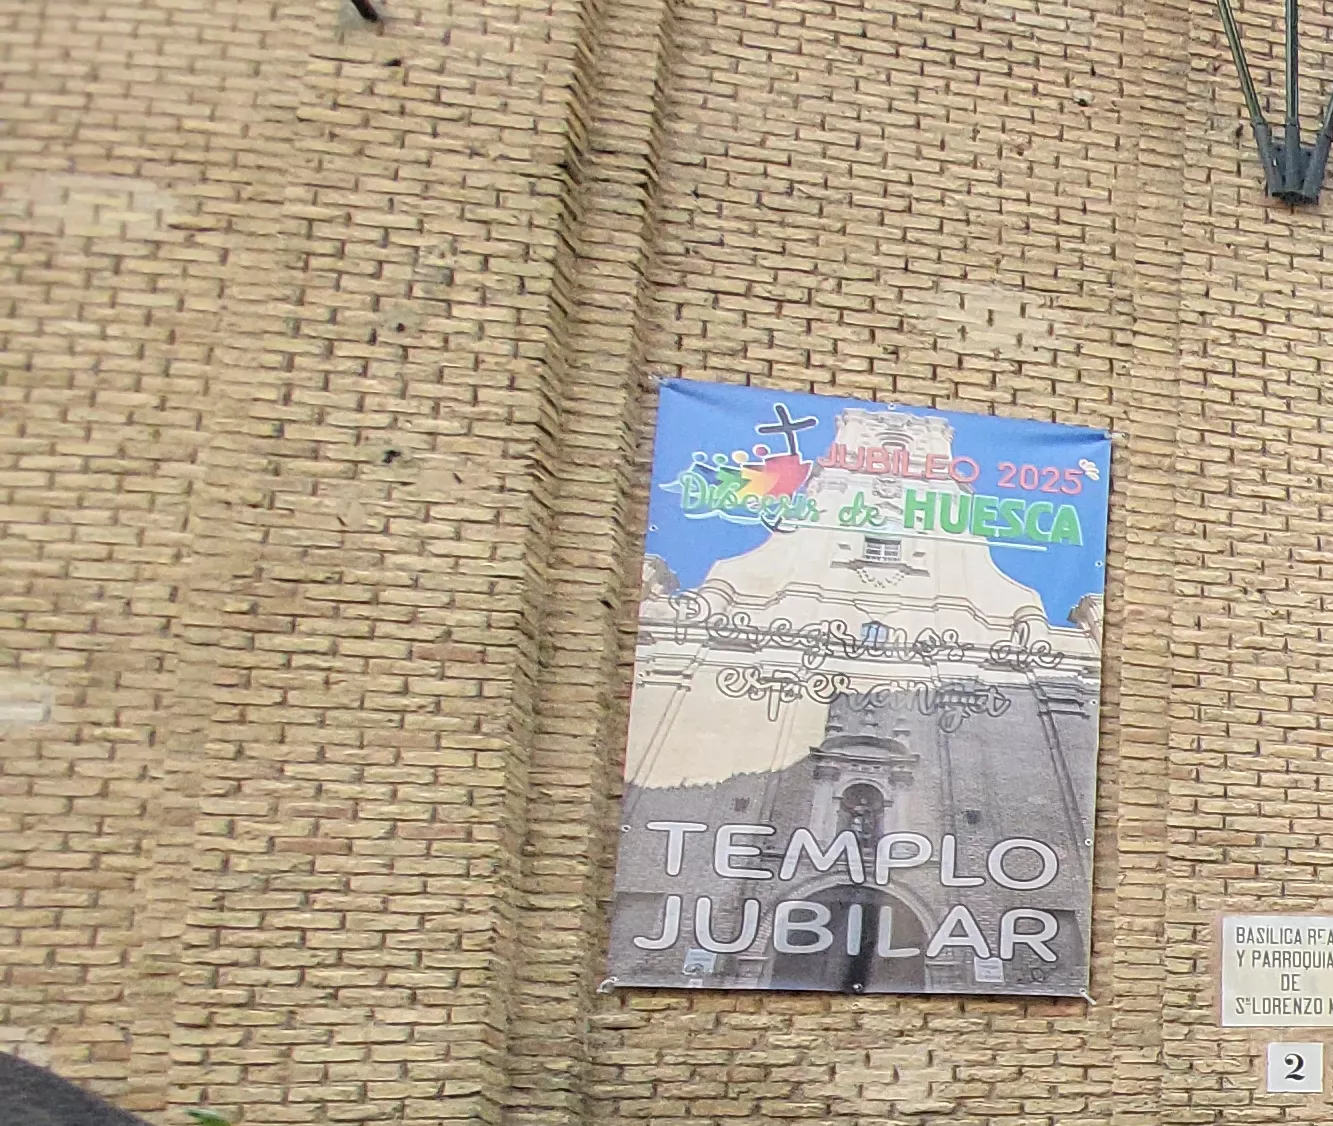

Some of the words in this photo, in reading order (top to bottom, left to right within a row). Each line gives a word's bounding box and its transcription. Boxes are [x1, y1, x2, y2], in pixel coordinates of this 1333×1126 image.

[818, 441, 979, 483] JUBILEO
[997, 461, 1084, 495] 2025
[838, 491, 890, 528] de
[903, 488, 1084, 546] HUESCA
[668, 591, 974, 671] Peregrinos
[988, 619, 1065, 671] de
[646, 820, 1060, 891] TEMPLO
[632, 895, 1060, 964] JUBILAR
[1236, 925, 1302, 944] BASÍLICA
[1236, 950, 1245, 968] Y
[1281, 973, 1301, 991] DE
[1252, 997, 1323, 1015] LORENZO
[1284, 1053, 1305, 1081] 2
